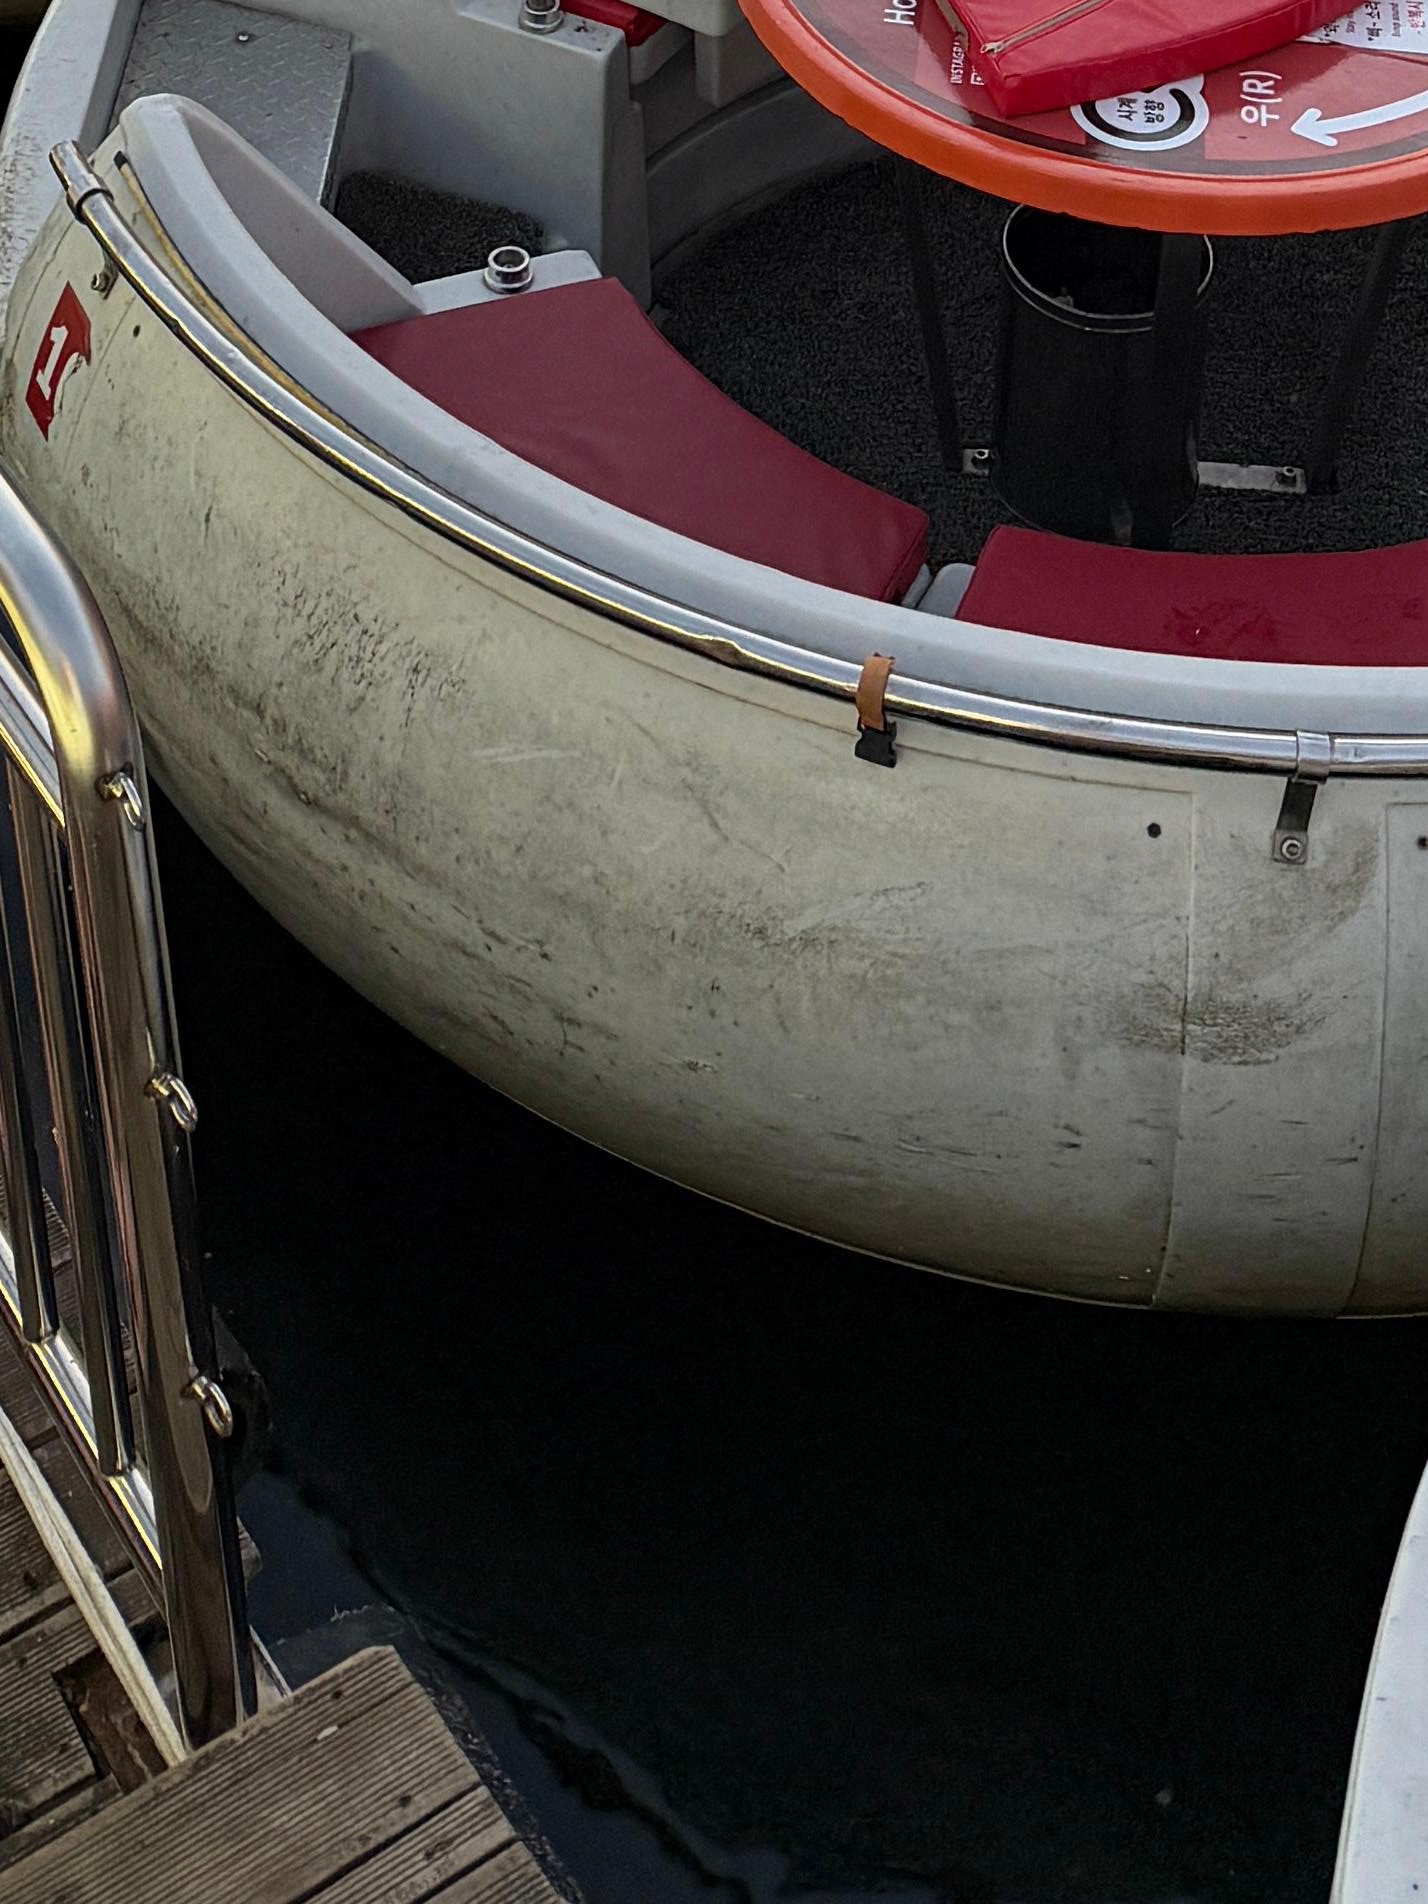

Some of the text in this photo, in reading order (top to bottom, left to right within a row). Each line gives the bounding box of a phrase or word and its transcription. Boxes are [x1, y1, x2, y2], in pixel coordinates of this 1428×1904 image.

[1117, 96, 1139, 122] 시계
[1143, 98, 1166, 124] 방향
[1238, 69, 1283, 128] 우(R)
